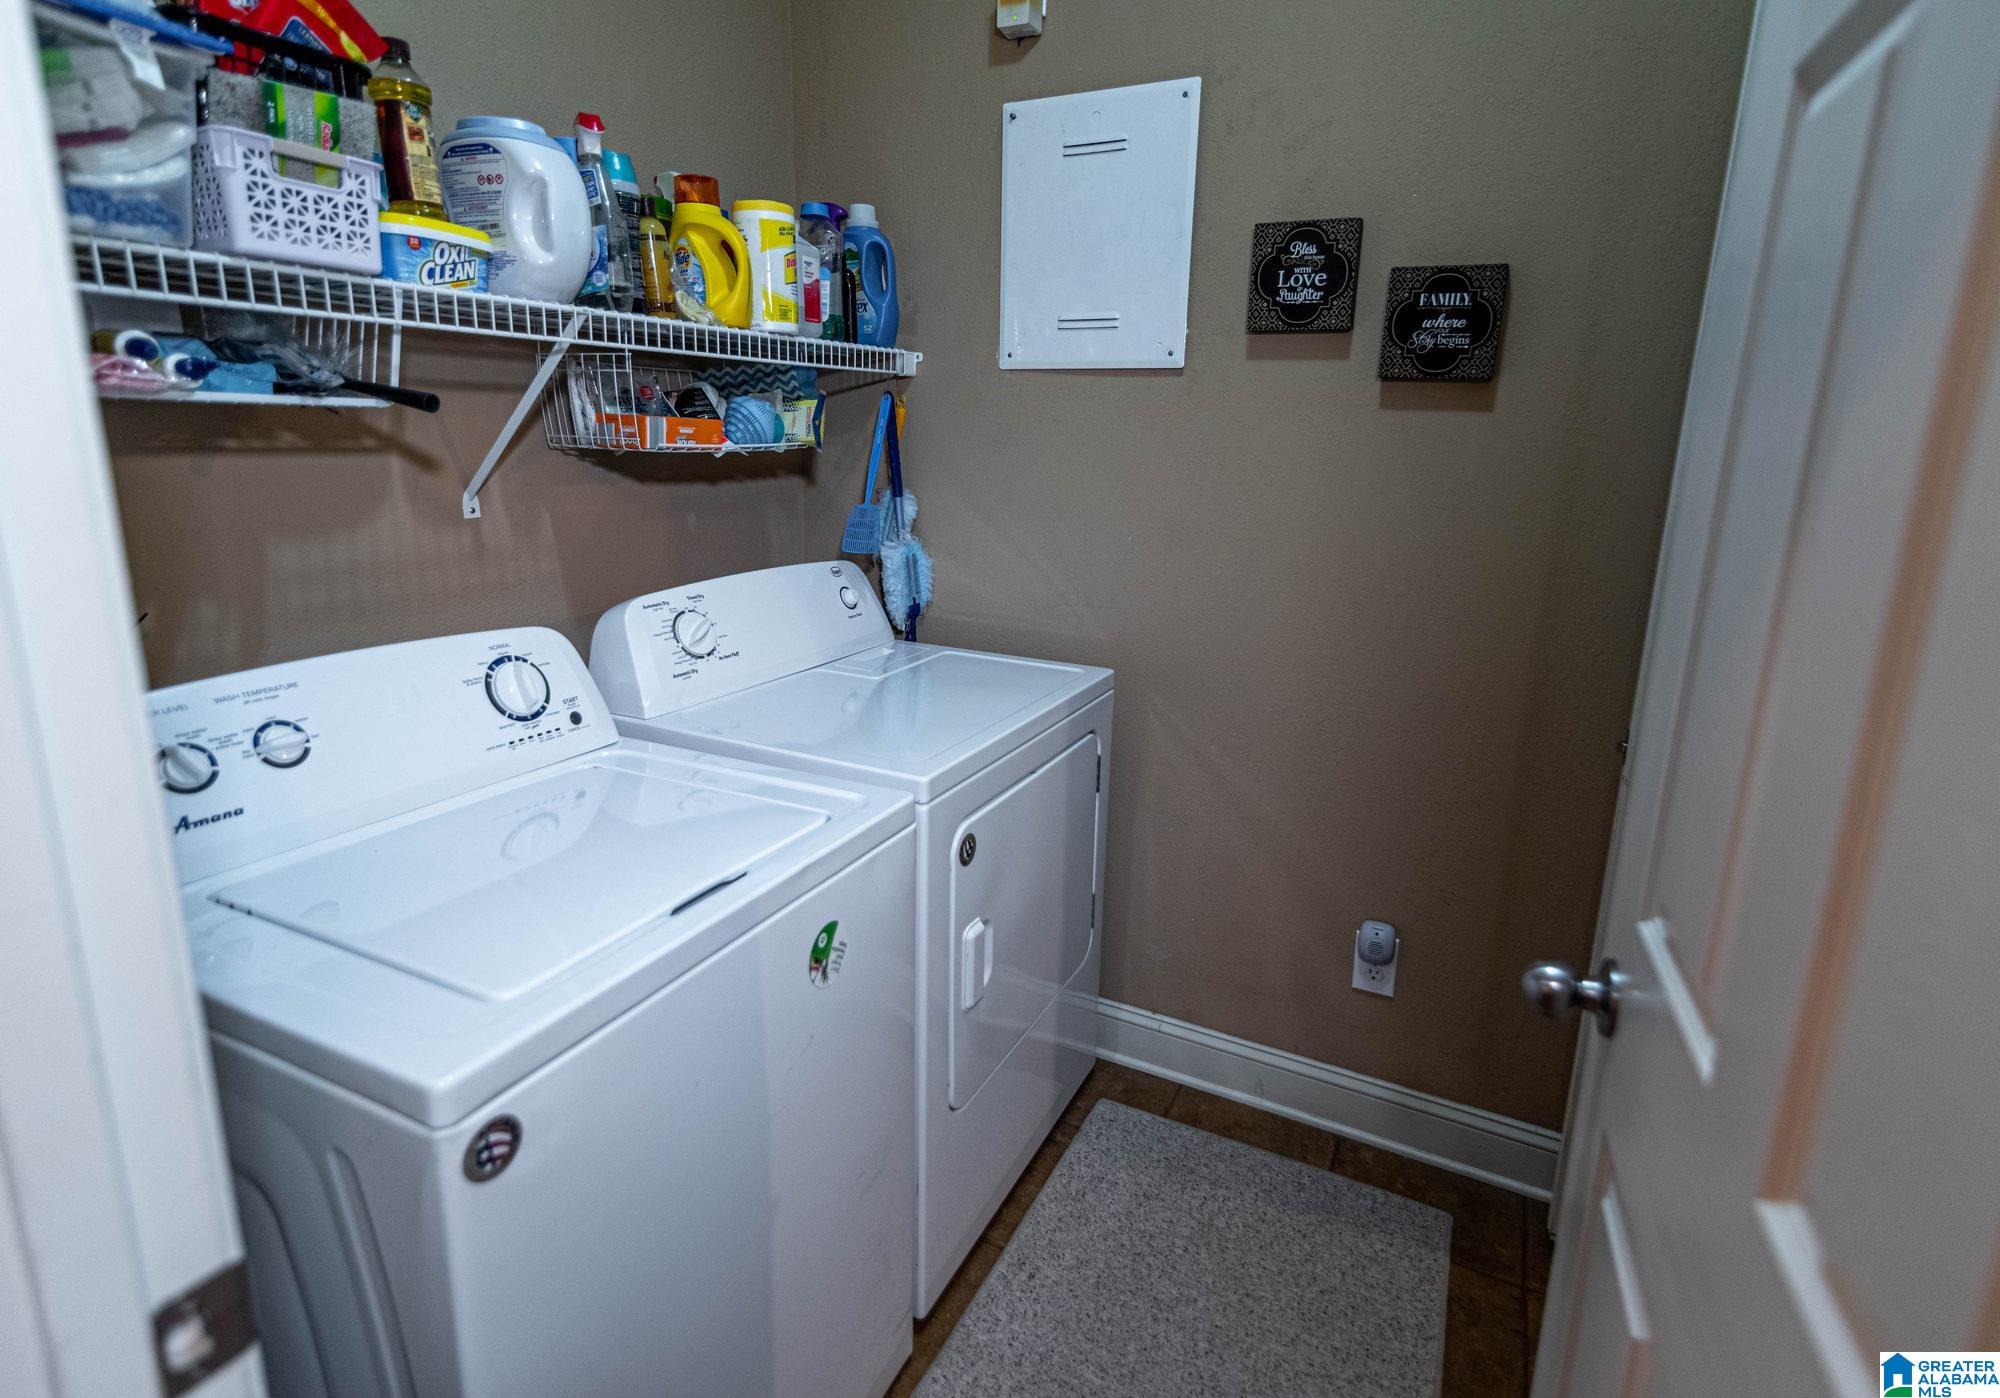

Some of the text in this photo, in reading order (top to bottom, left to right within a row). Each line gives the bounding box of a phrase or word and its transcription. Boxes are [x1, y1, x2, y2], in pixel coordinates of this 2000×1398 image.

[433, 241, 467, 266] OXI
[1290, 241, 1318, 258] Bless
[674, 251, 690, 266] Tide
[420, 260, 477, 286] CLEAN
[1294, 266, 1312, 274] WITH
[1277, 270, 1328, 288] Love
[1421, 312, 1468, 328] where
[1437, 334, 1471, 349] begins
[213, 680, 300, 704] WASH TEMPERATURE
[562, 695, 579, 705] START
[174, 807, 244, 835] Amana
